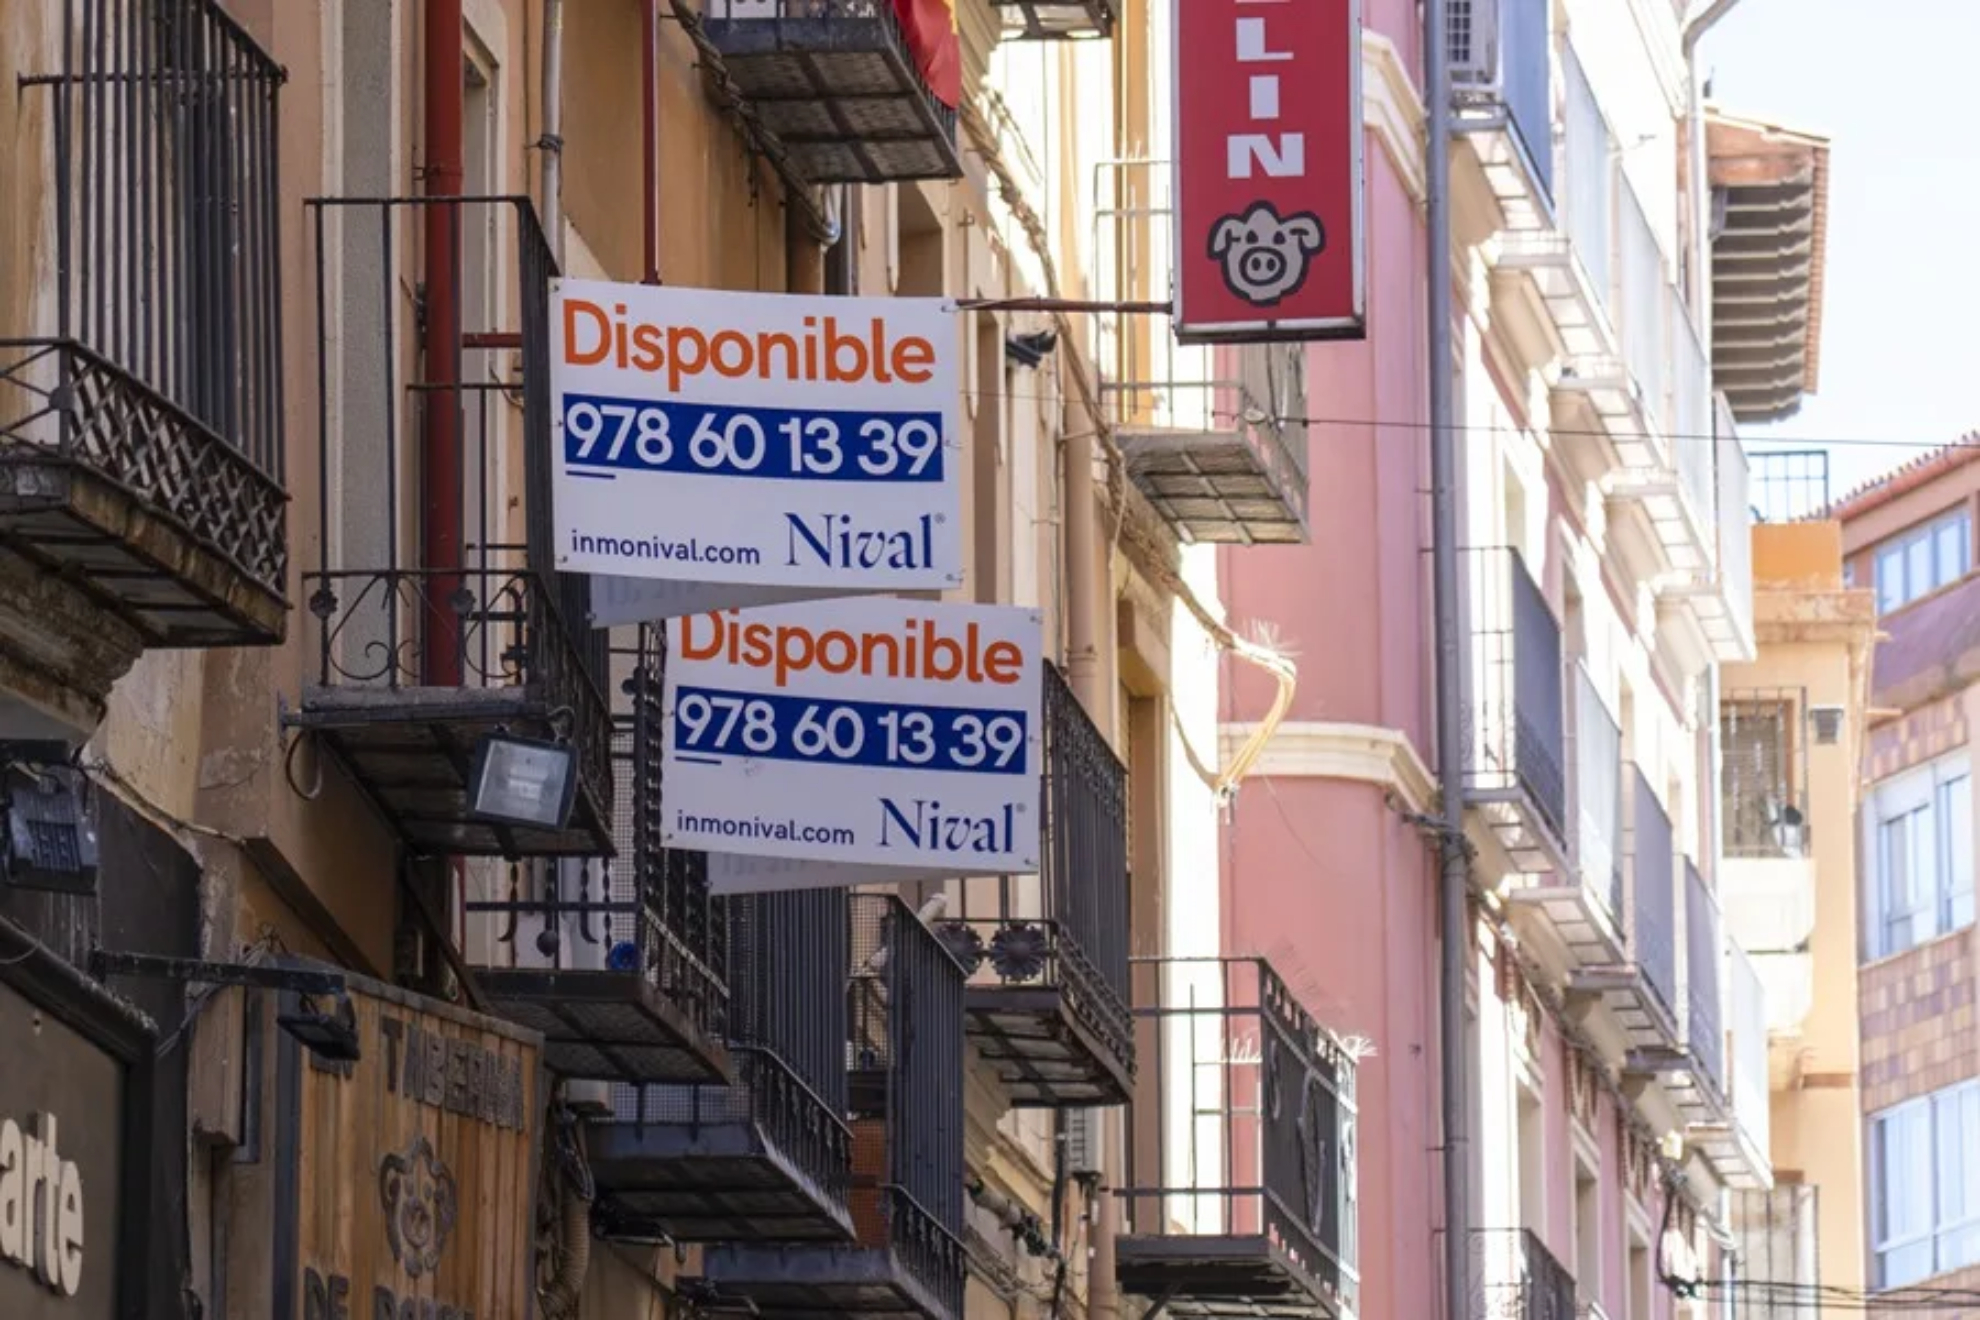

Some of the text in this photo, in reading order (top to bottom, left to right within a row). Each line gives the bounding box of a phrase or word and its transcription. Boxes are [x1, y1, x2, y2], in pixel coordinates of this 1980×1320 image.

[1227, 0, 1305, 179] LIN
[563, 299, 935, 392] Disponible
[566, 402, 938, 475] 978 60 13 39
[571, 529, 760, 565] inmonival.com
[680, 609, 1023, 687] Disponible
[677, 695, 1023, 767] 978 60 13 39
[676, 809, 855, 846] inmonival.com
